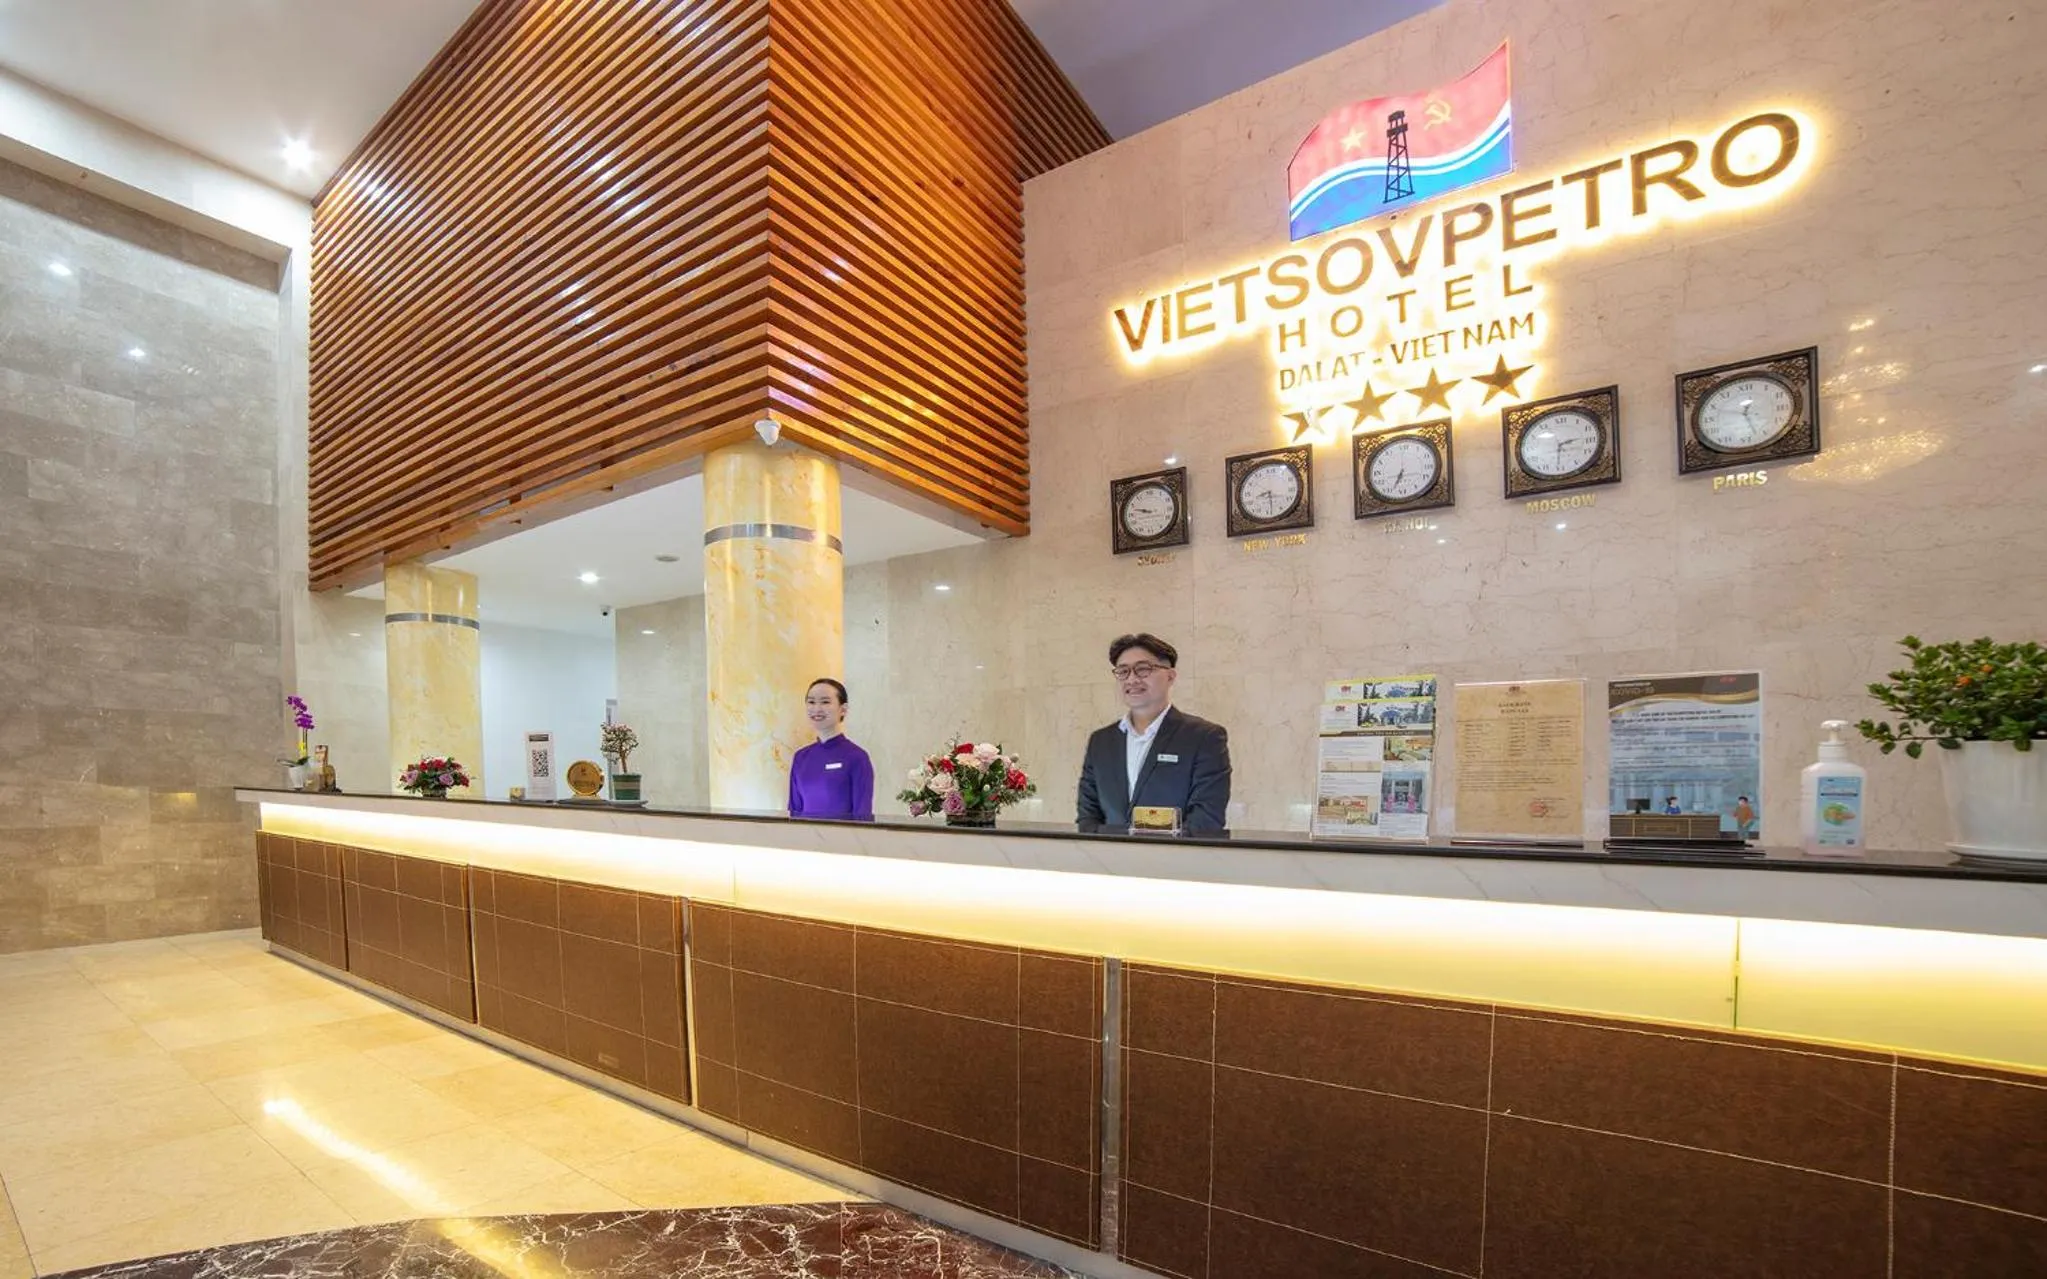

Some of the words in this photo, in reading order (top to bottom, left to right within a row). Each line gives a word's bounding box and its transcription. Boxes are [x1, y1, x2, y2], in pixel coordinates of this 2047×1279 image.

[1114, 112, 1800, 352] VIETSOVPETRO
[1278, 264, 1534, 353] HOTEL
[1279, 351, 1366, 391] DALAT
[1712, 470, 1769, 490] PARIS
[1526, 493, 1597, 514] MOSCOW
[1243, 538, 1270, 553] NEW
[1274, 532, 1307, 549] YORK
